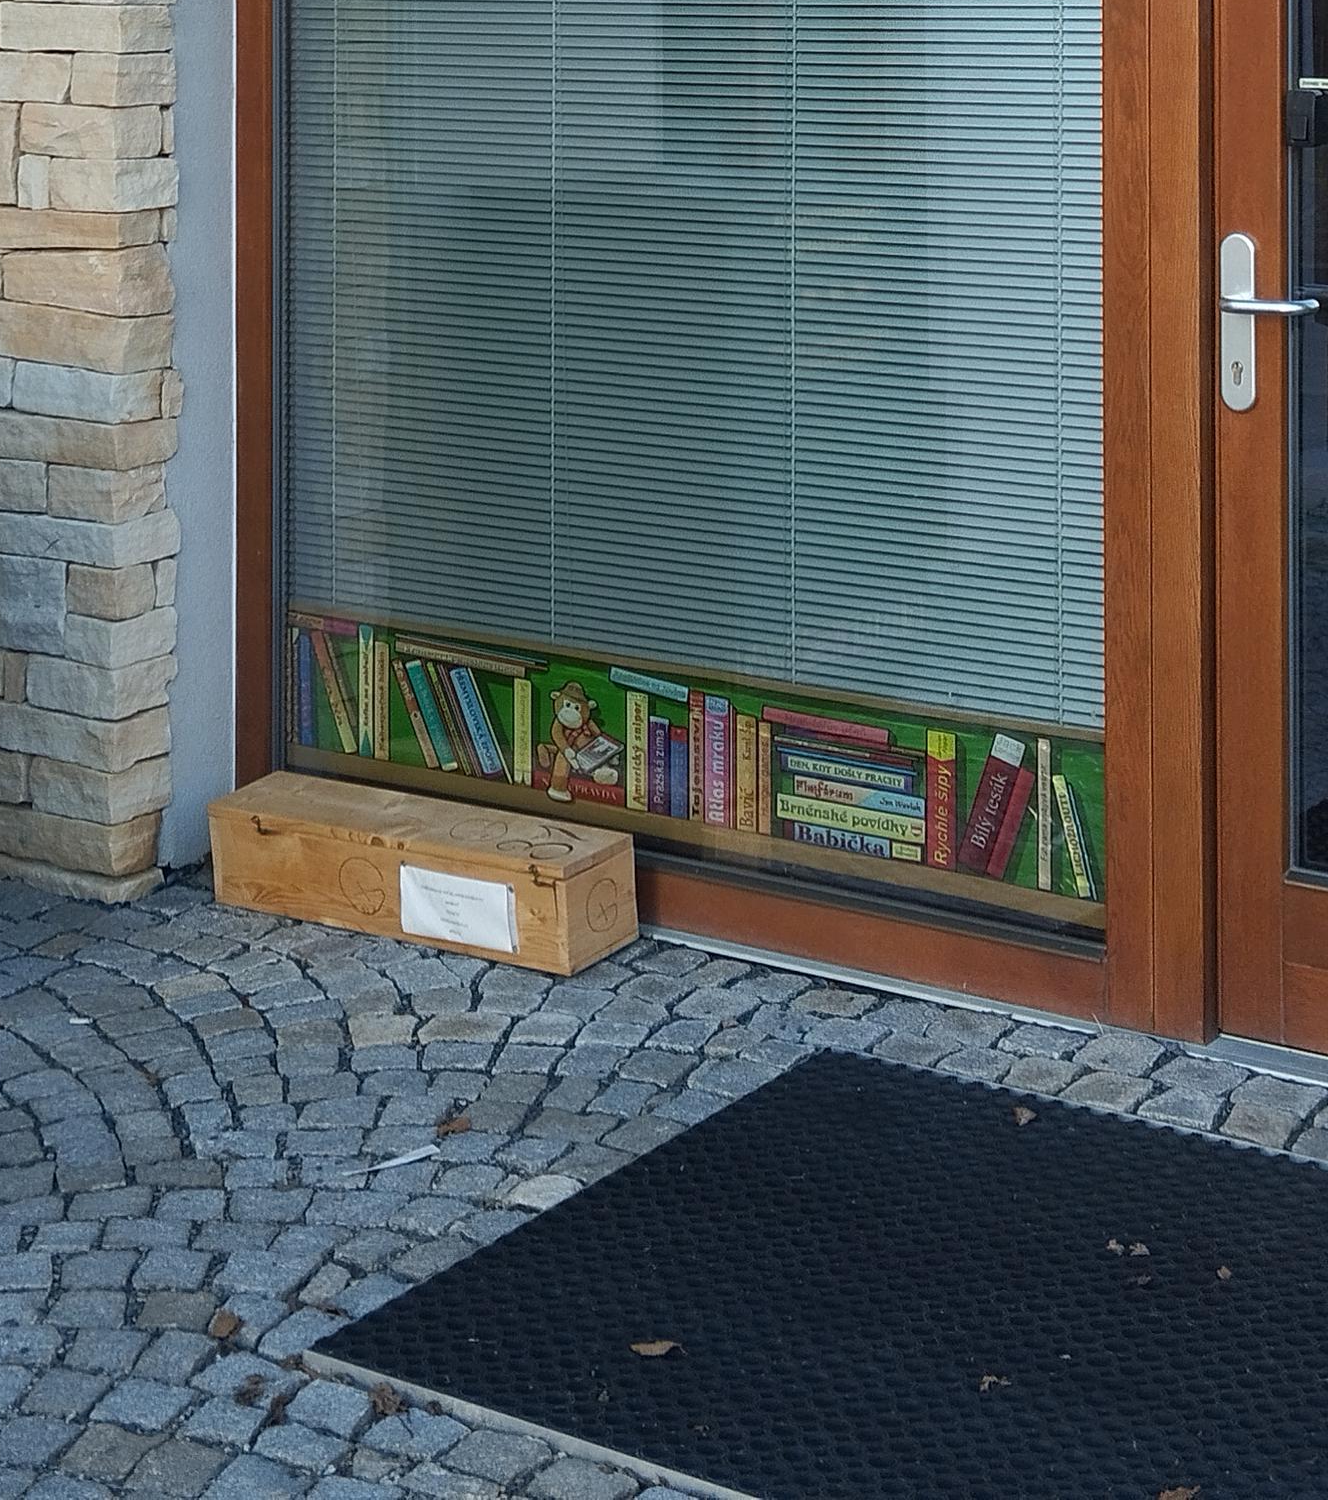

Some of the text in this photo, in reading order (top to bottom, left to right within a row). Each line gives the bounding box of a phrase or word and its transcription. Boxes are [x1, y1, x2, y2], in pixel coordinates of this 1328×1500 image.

[631, 701, 644, 746] sniper
[631, 748, 644, 807] Americký
[653, 729, 665, 805] Pražská zima
[864, 772, 903, 788] PRACHY
[934, 764, 953, 802] šípy
[708, 780, 725, 823] Atlas
[779, 799, 909, 837] Brněnské povídky
[970, 772, 1008, 850] Bílý tesák
[797, 823, 886, 857] Babička
[934, 805, 952, 865] Rychlé
